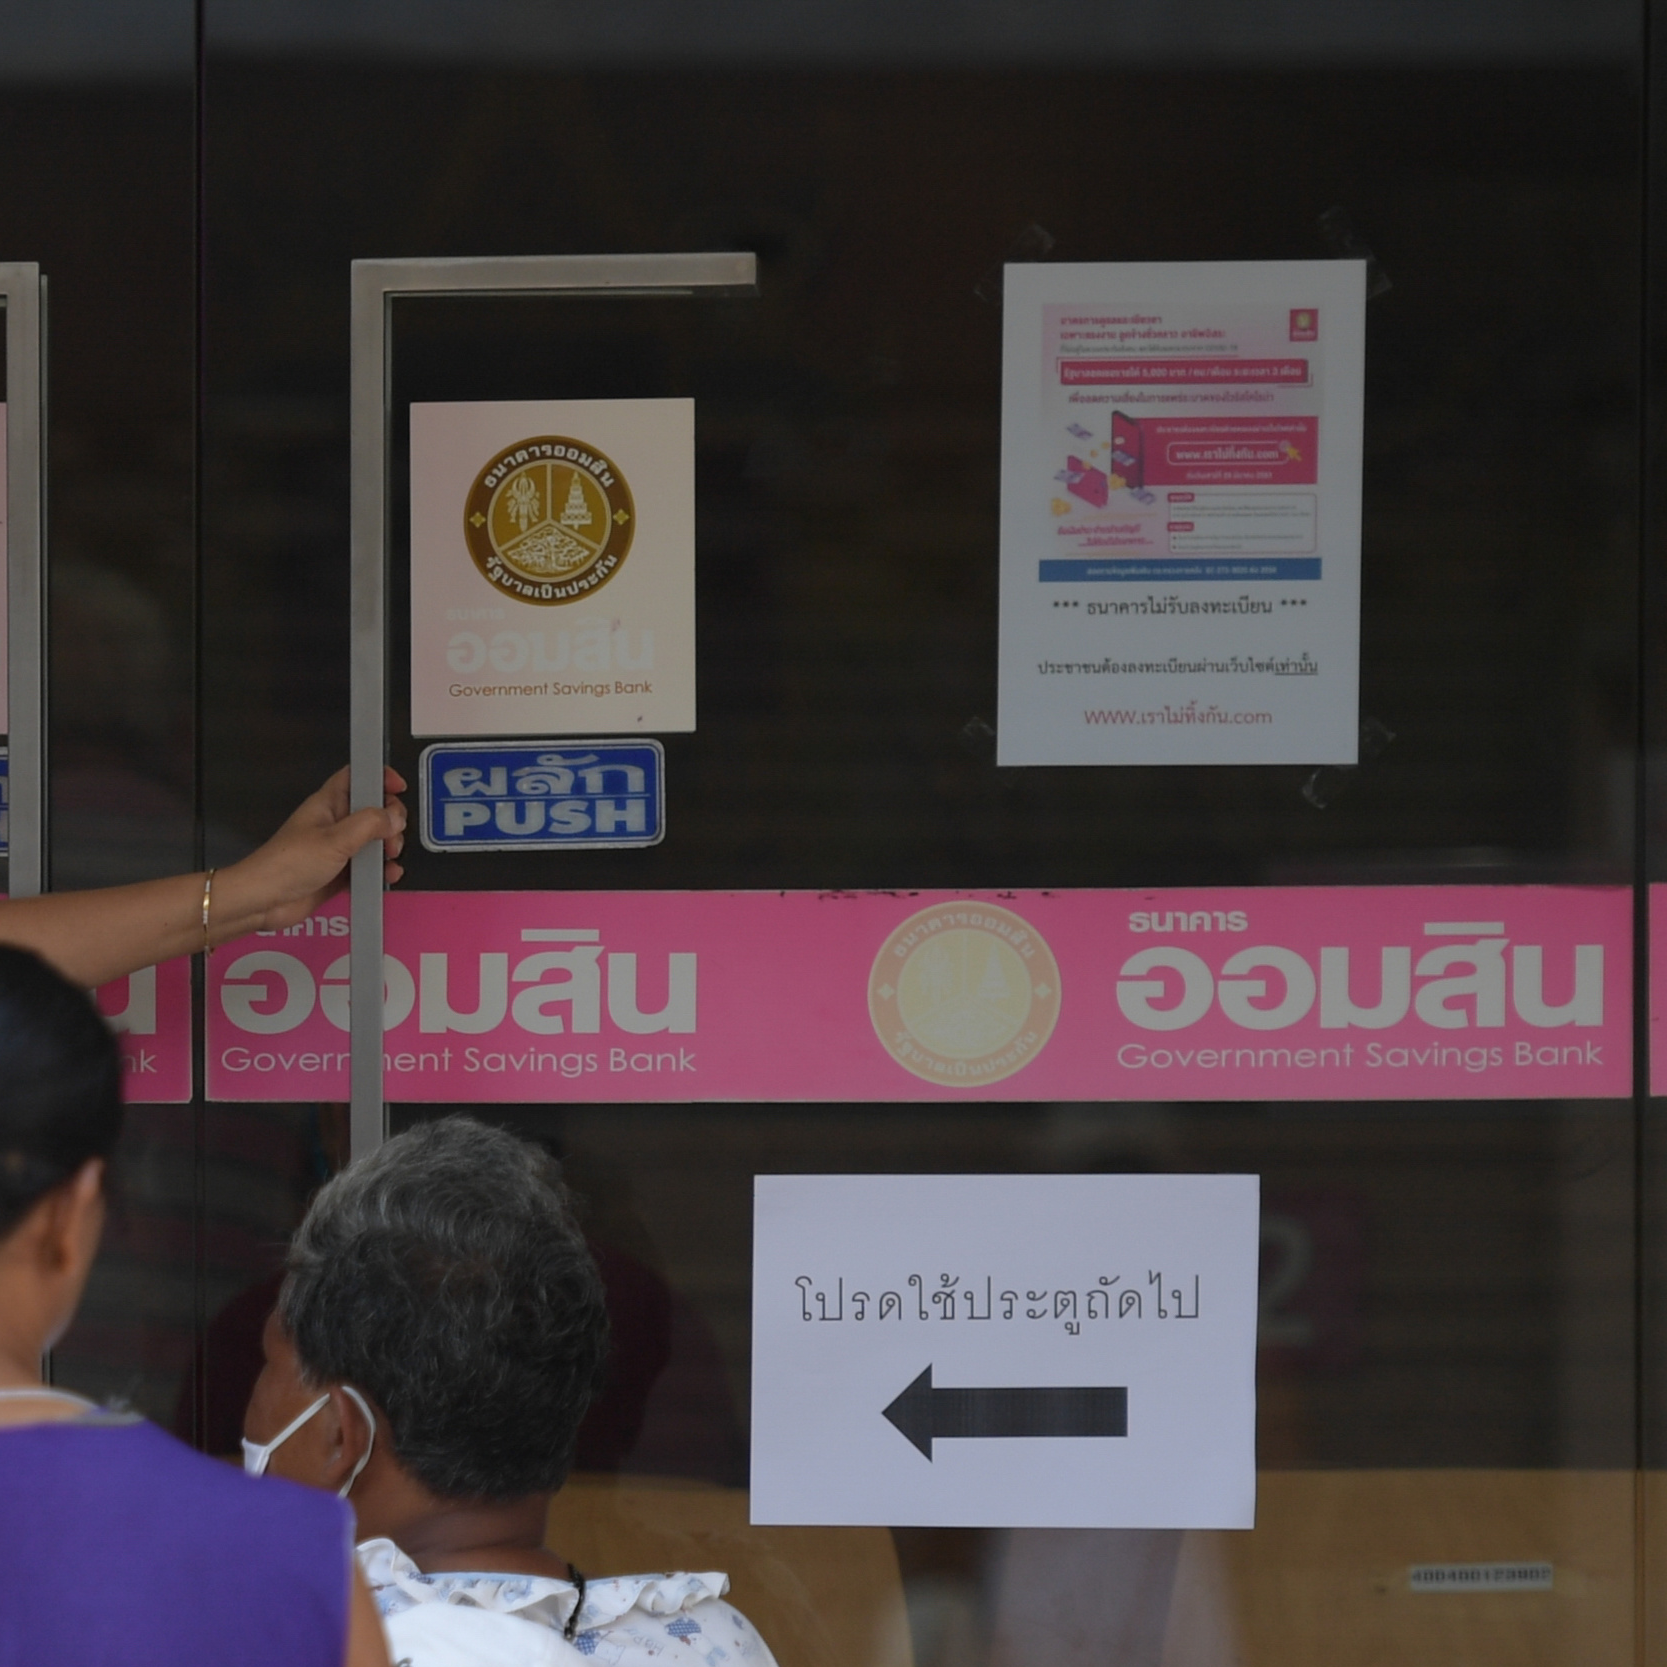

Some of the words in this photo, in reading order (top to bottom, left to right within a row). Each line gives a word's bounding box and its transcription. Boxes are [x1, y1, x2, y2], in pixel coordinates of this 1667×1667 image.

[483, 443, 616, 489] ธนาคารออมสิน
[483, 553, 618, 600] รัฐบาลเป็นประกัน
[449, 683, 548, 697] Government
[553, 682, 611, 697] Savings
[615, 680, 653, 694] Bank
[443, 753, 646, 797] ผลัก
[443, 799, 647, 837] PUSH
[1127, 911, 1249, 934] ธนาคาร
[220, 928, 698, 1036] ออมสิน
[1115, 921, 1605, 1031] ออมสิน
[463, 1046, 599, 1078] Savings
[609, 1046, 697, 1073] Bank
[1116, 1043, 1354, 1070] Government
[1365, 1042, 1504, 1073] Savings
[1514, 1040, 1605, 1067] Bank
[793, 1268, 1202, 1336] โปรดใช้ประตูถัดไป
